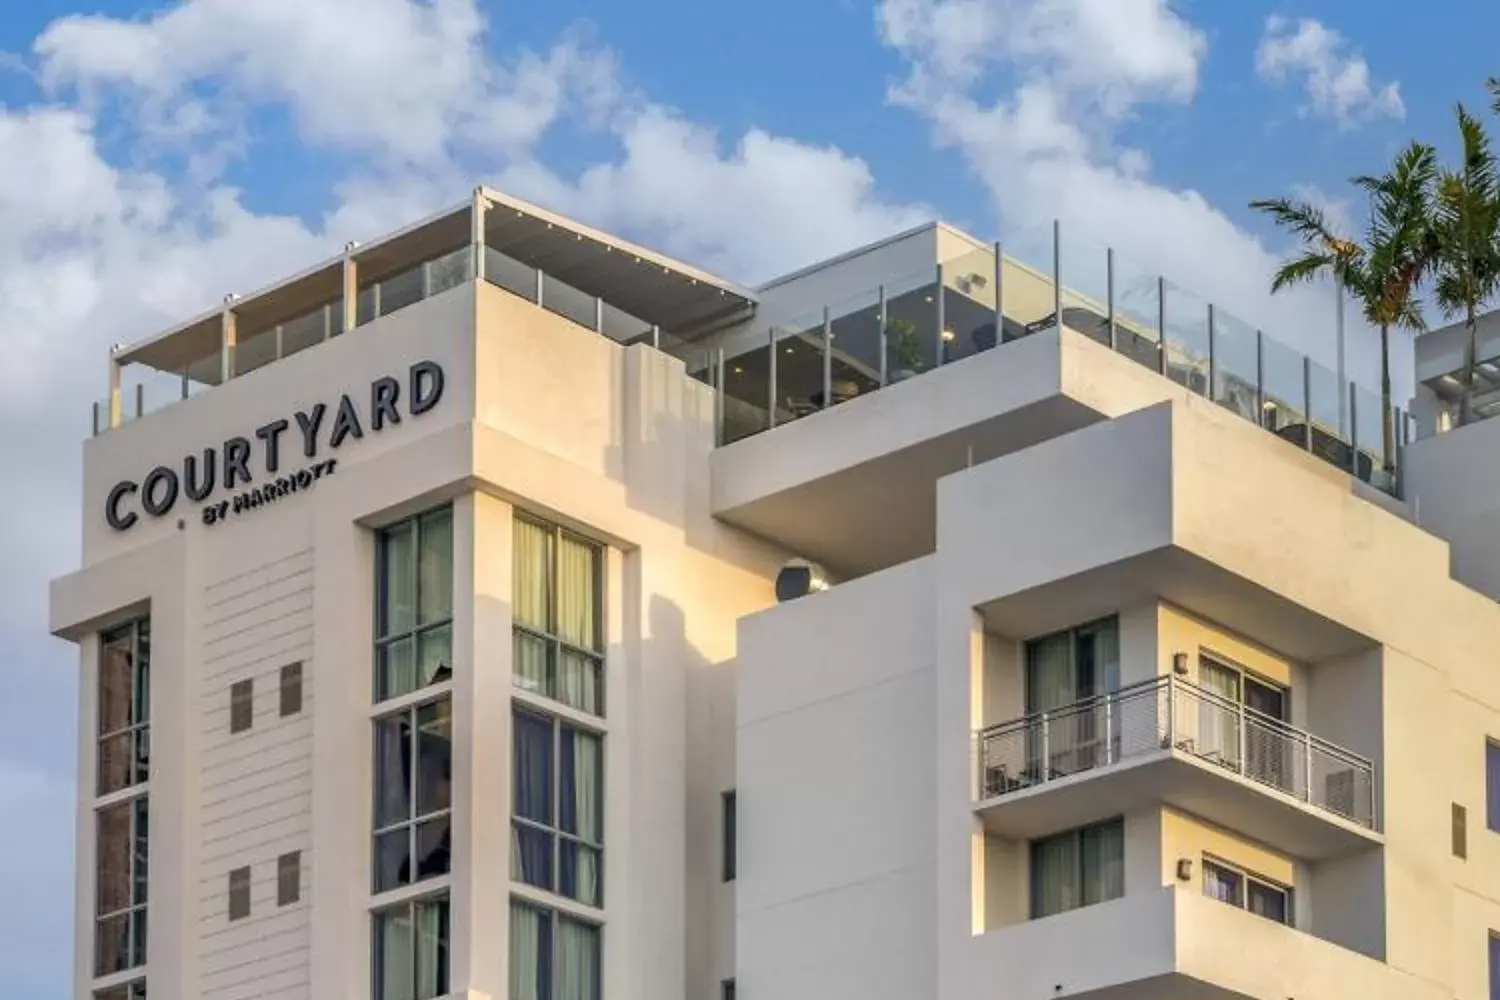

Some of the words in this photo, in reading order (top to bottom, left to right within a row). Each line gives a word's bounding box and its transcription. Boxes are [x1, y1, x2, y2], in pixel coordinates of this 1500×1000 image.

[105, 360, 445, 531] COURTYARD
[202, 501, 229, 525] BY
[233, 459, 337, 514] MARRIOTT
